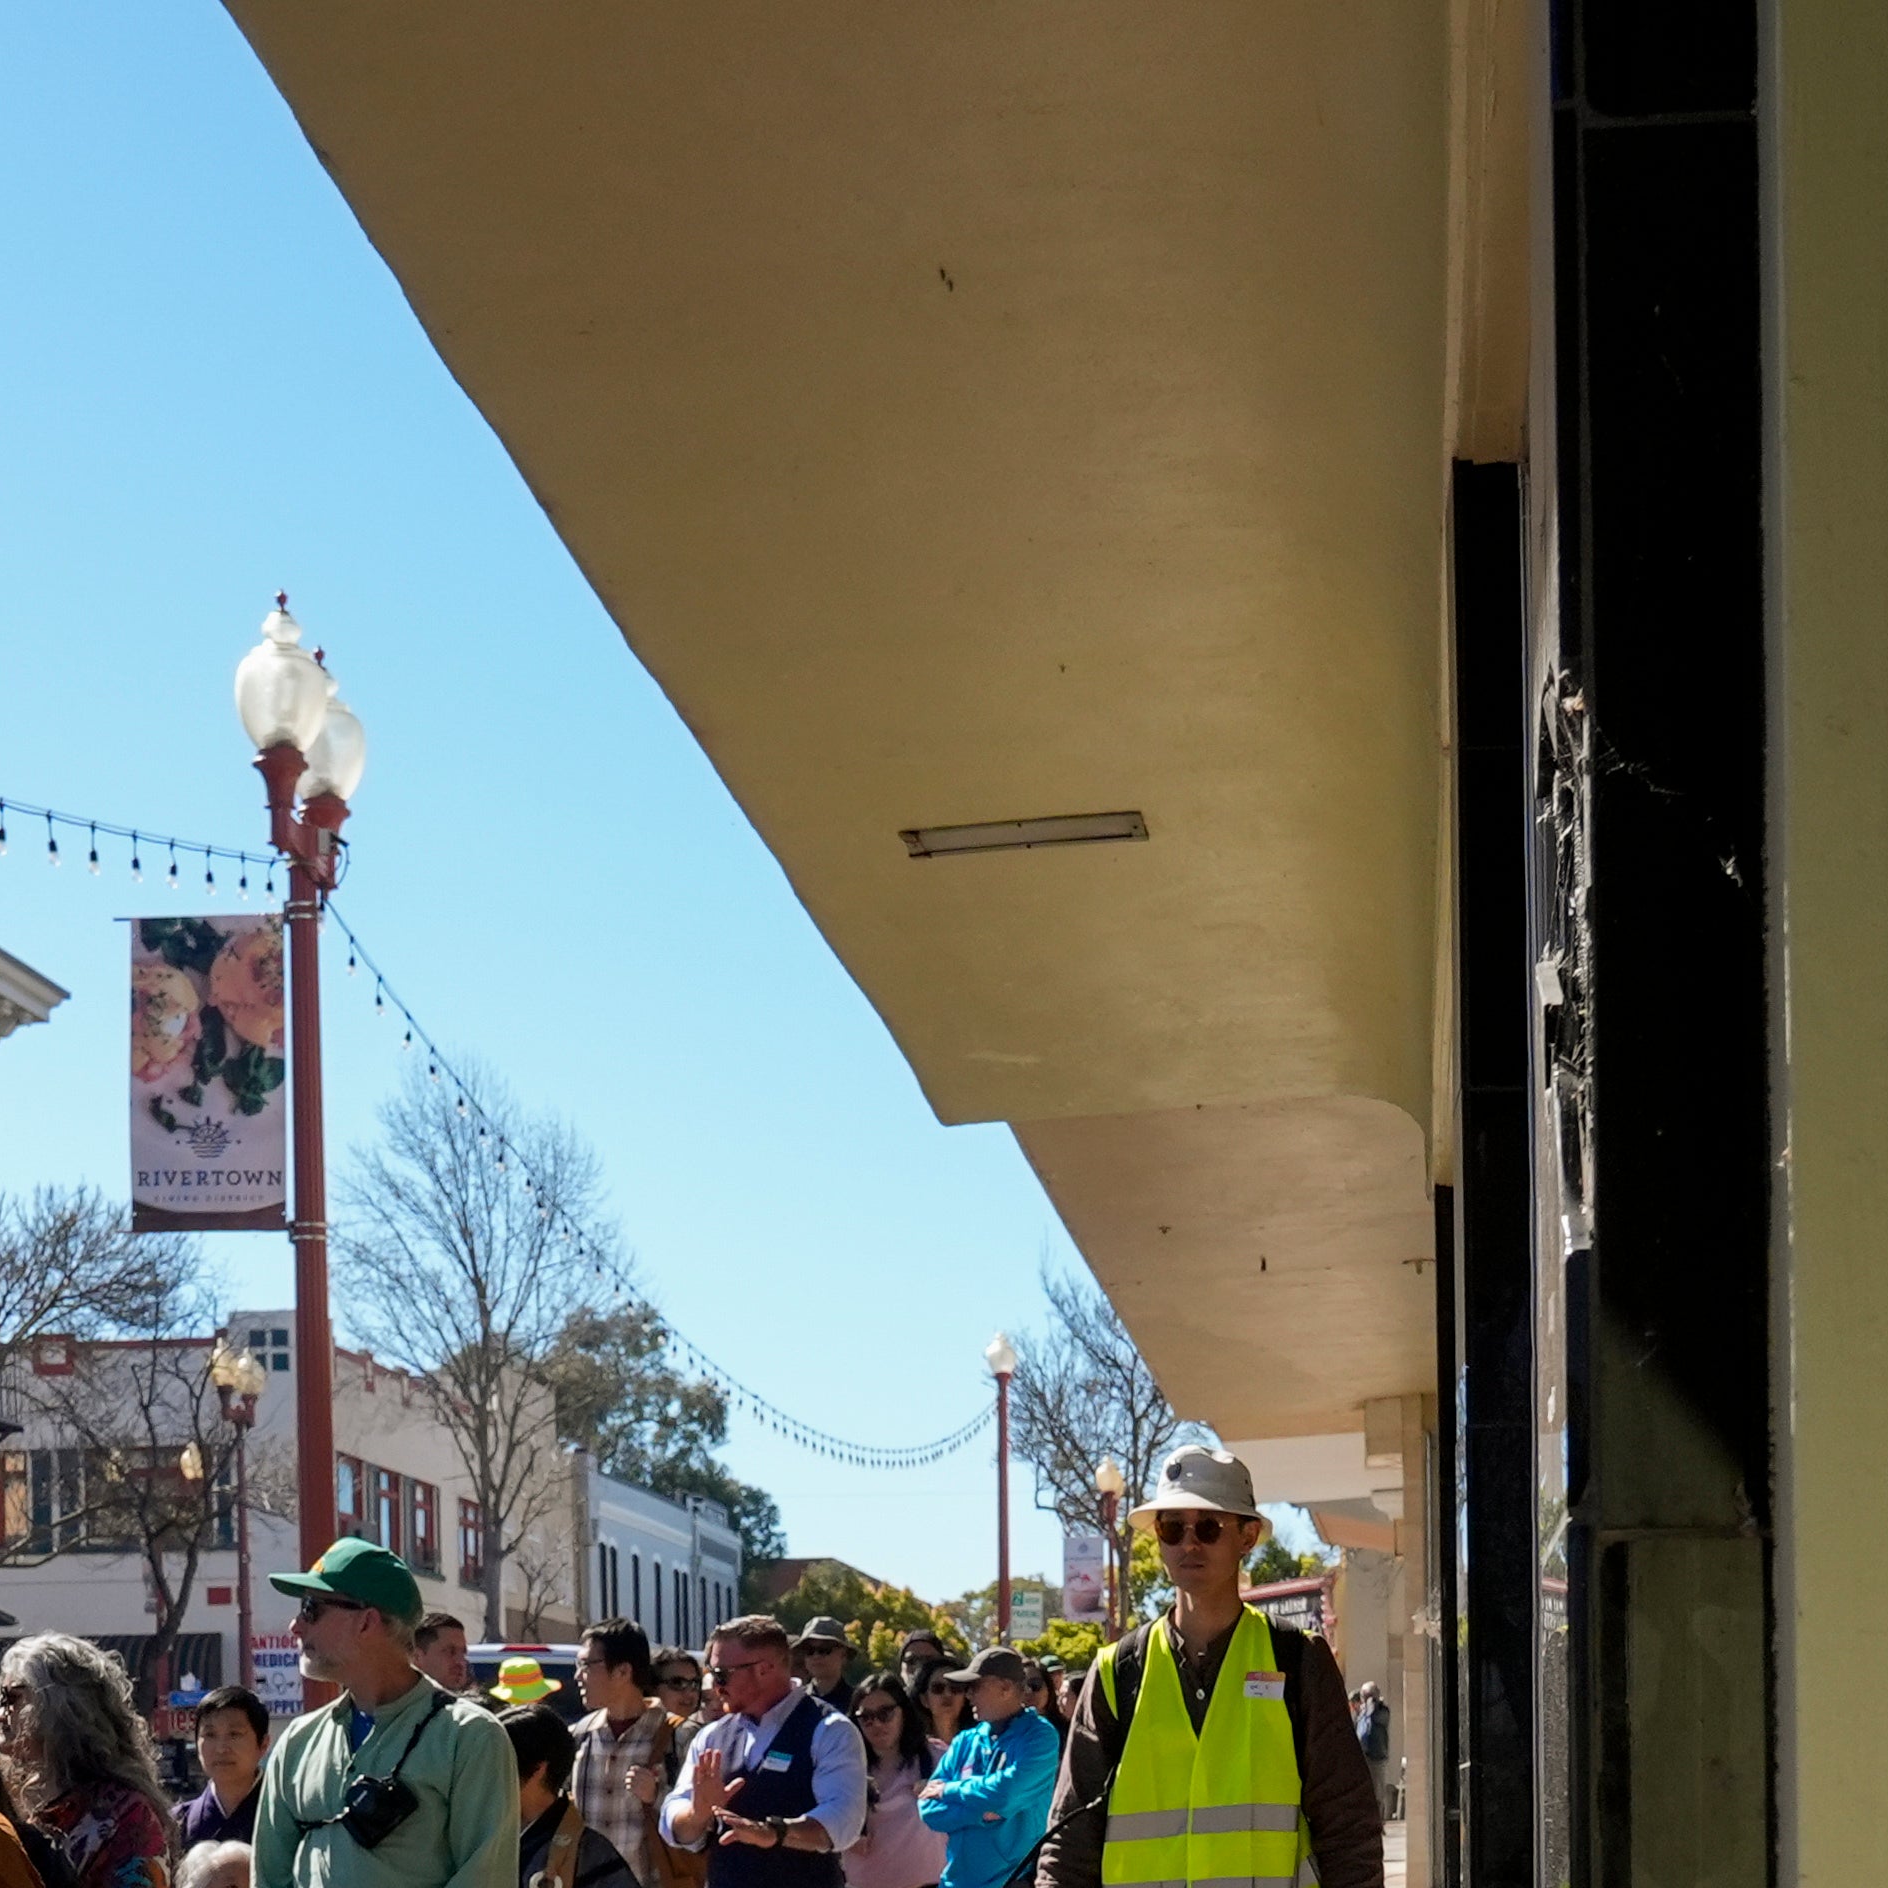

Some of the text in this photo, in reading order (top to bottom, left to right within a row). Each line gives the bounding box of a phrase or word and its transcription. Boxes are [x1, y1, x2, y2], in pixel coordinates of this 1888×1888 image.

[137, 1169, 283, 1187] RIVERTOWN
[250, 1634, 299, 1650] ANTIOC
[253, 1652, 299, 1668] MEDICA
[264, 1699, 303, 1715] UPPLY
